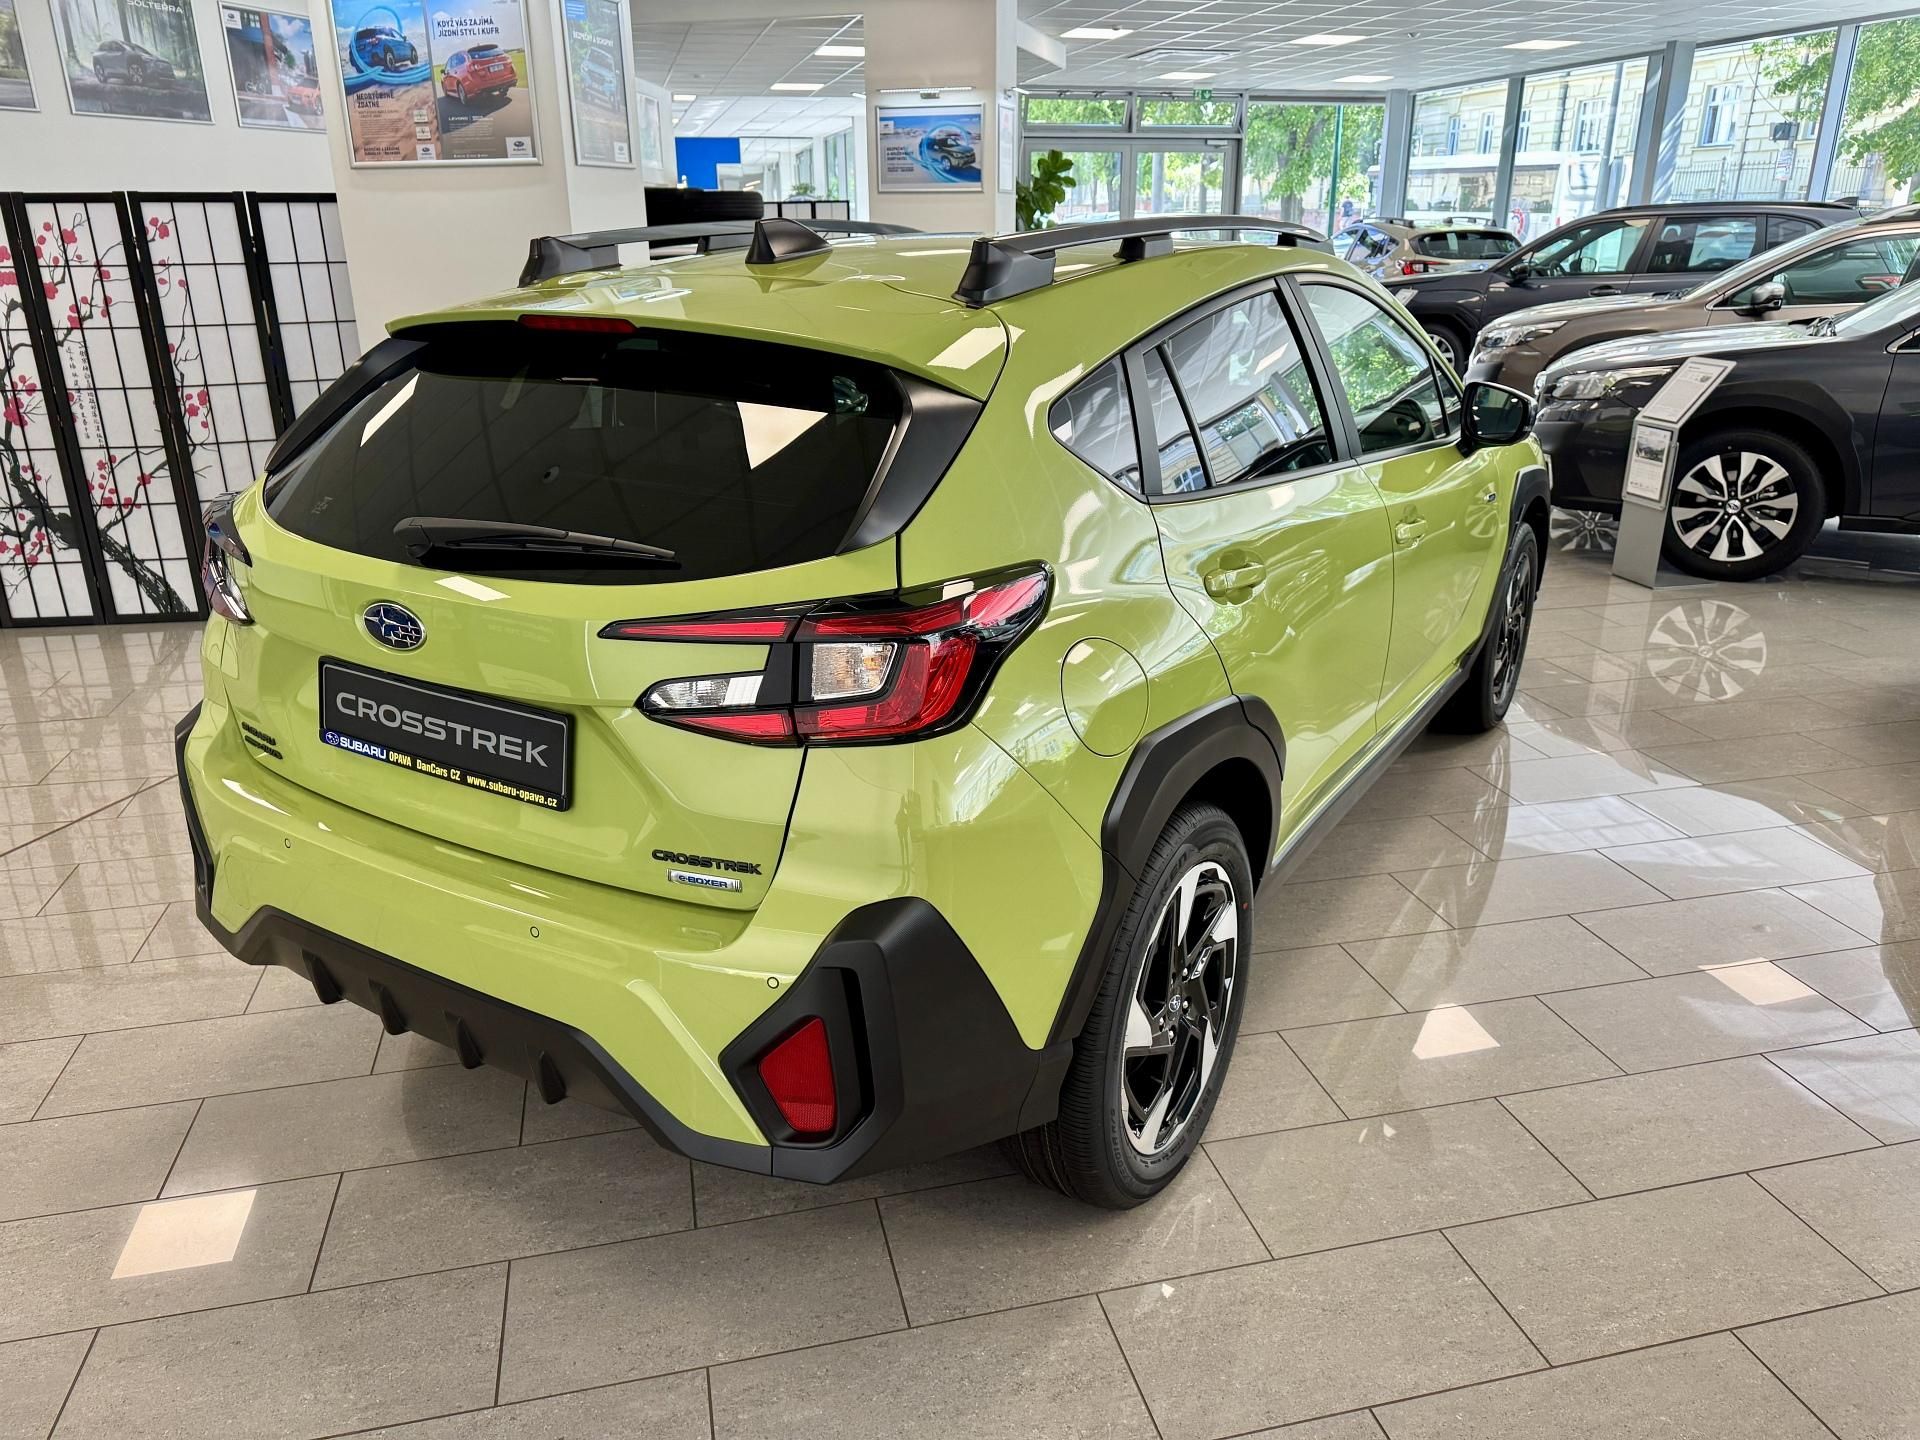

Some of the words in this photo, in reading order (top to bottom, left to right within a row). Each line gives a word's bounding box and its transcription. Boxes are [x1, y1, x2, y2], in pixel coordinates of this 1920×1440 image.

[437, 17, 454, 28] KDYŽ
[455, 17, 467, 27] VÁS
[469, 15, 494, 26] ZAJÍMÁ
[438, 27, 459, 37] JÍZDNÍ
[460, 28, 476, 36] STYL
[482, 26, 499, 35] KUFR
[336, 692, 550, 768] CROSSTREK
[339, 736, 387, 760] SUBARU
[389, 751, 412, 767] OPAVA
[416, 759, 448, 778] DanCars
[450, 768, 461, 781] CZ
[466, 774, 558, 807] www.subaru-opava.cz
[651, 849, 762, 875] CROSSTREK
[678, 874, 728, 888] e-BOXER
